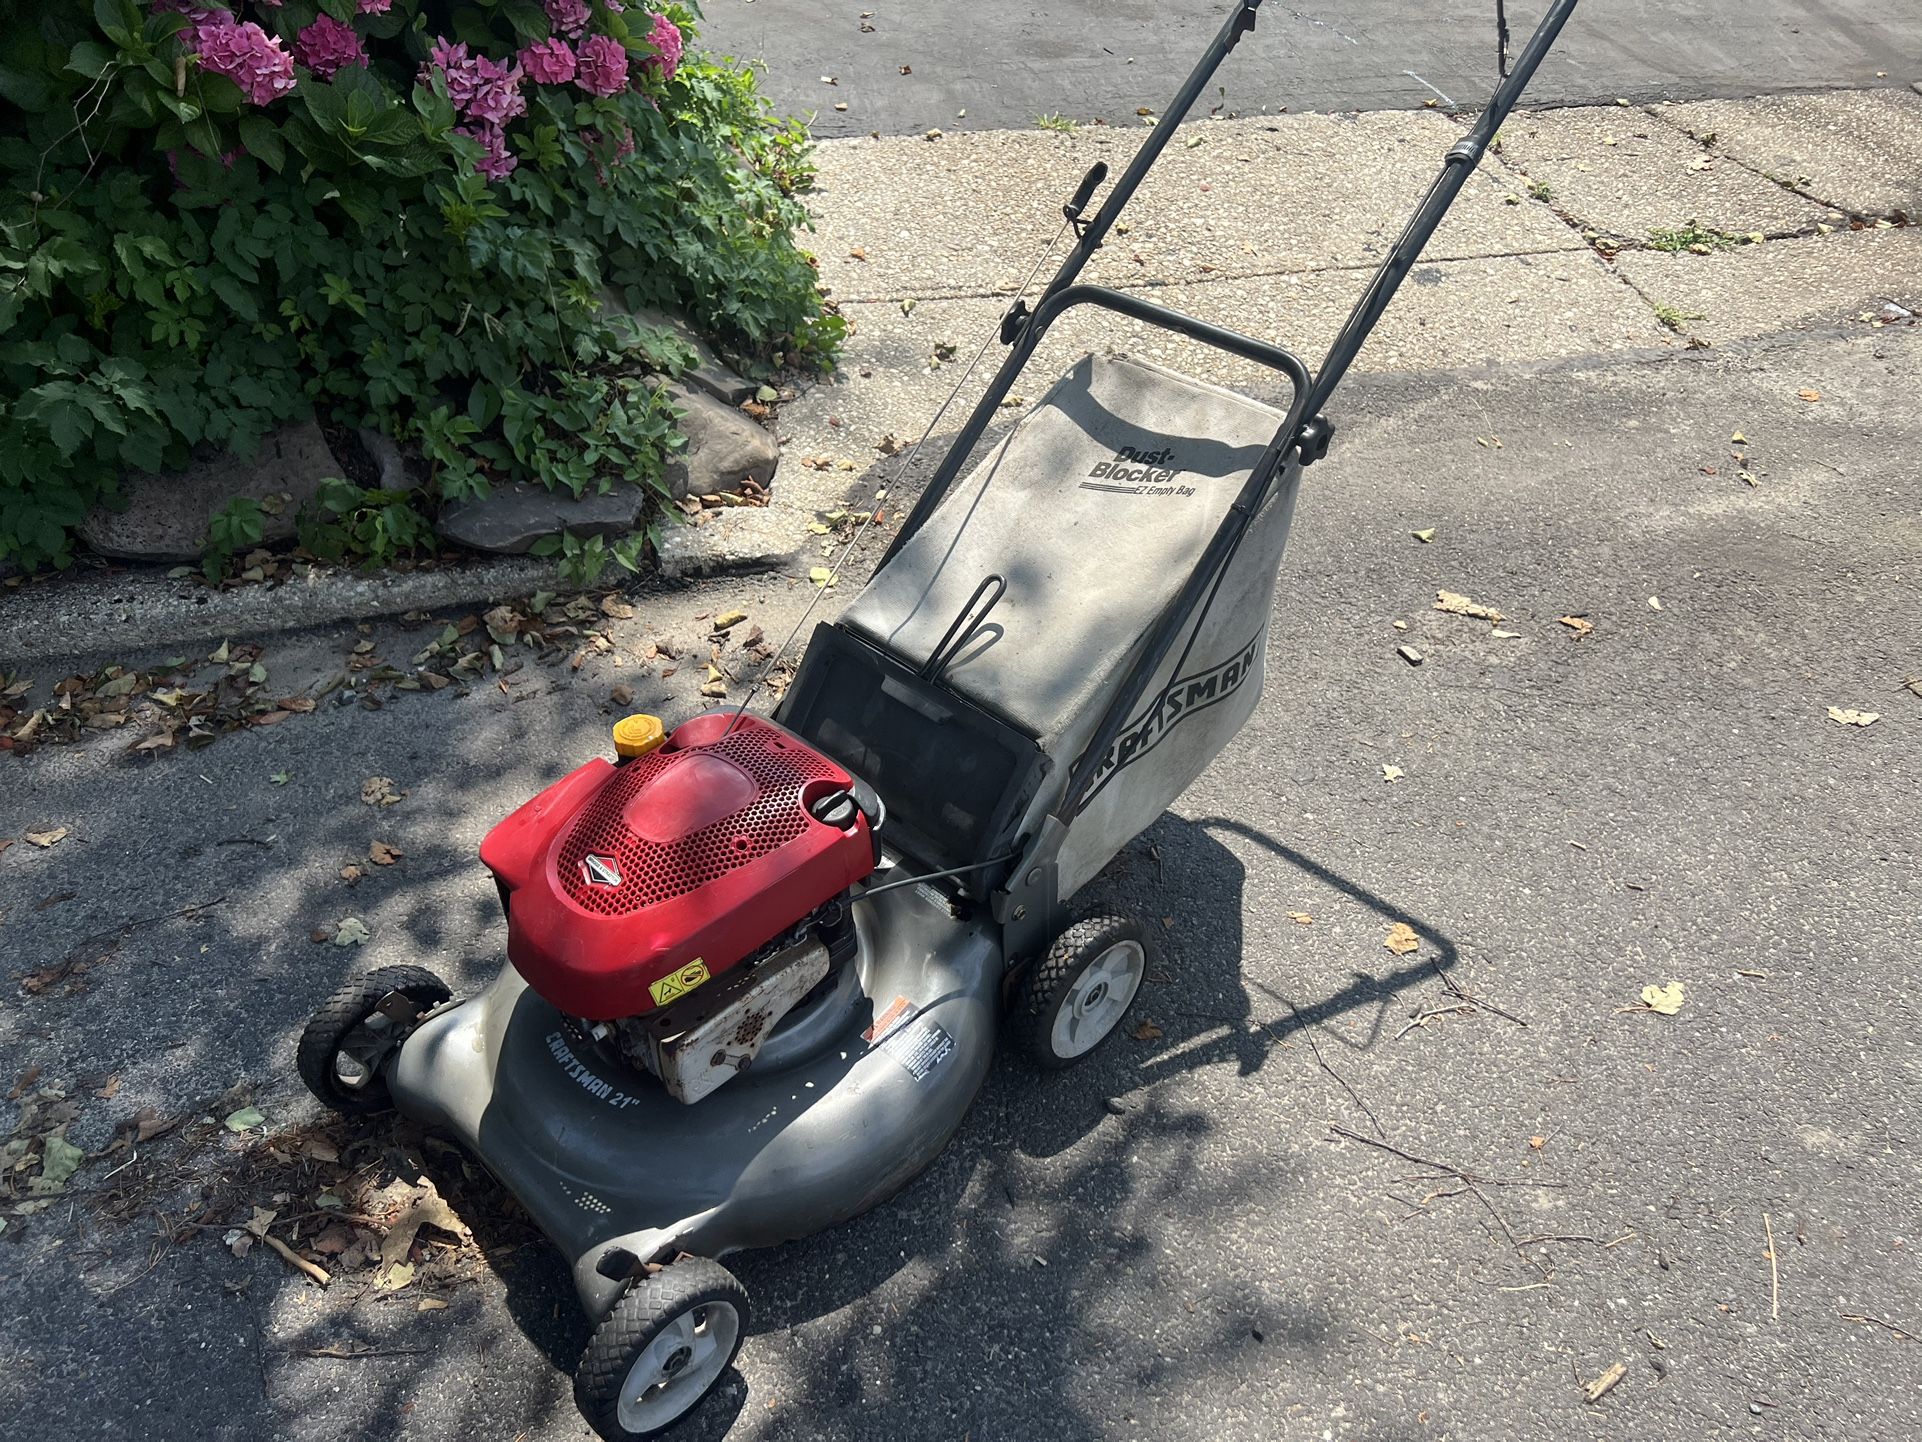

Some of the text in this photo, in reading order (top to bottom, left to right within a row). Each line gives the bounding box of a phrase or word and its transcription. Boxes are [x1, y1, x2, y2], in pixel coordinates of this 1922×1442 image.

[1088, 461, 1186, 483] Blocker
[1133, 485, 1196, 497] EZ Empty Bag
[1083, 642, 1256, 793] RAFTSMAN
[545, 1031, 640, 1109] CRAFTSMAN 21"
